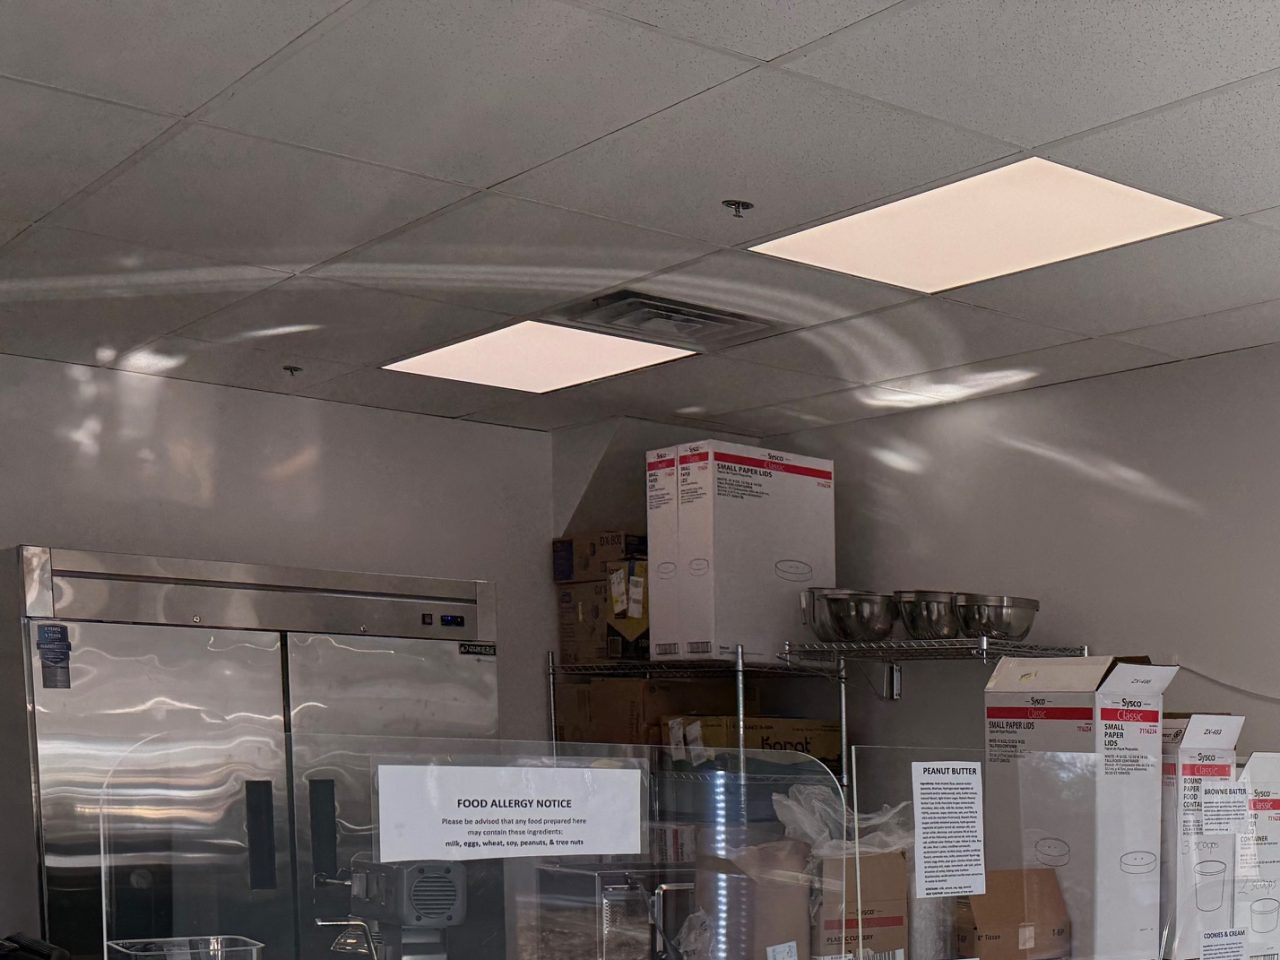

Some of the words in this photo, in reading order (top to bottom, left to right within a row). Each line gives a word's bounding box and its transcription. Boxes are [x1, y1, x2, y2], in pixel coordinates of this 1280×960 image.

[1030, 697, 1046, 707] Sysco
[1121, 698, 1142, 708] Sysco
[1117, 710, 1144, 721] Classic
[988, 721, 1005, 730] SMALL
[1005, 722, 1023, 730] PAPER
[1023, 721, 1035, 731] LIDS
[1104, 723, 1125, 731] SMALL
[1104, 731, 1125, 740] PAPER
[761, 735, 812, 753] Karat
[1197, 752, 1216, 763] Sysco
[922, 767, 951, 775] PEANUT
[951, 767, 977, 776] BUTTER
[1194, 764, 1219, 776] Classic
[1183, 793, 1198, 801] FOOD
[1204, 788, 1228, 796] BROWNIE
[1254, 789, 1271, 798] Sysco
[457, 799, 488, 809] FOOD
[490, 799, 534, 809] ALLERGY
[536, 799, 573, 809] NOTICE
[527, 817, 542, 825] food
[543, 818, 572, 827] prepared
[572, 817, 587, 825] here
[445, 840, 462, 848] milk,
[463, 841, 481, 849] eggs,
[482, 839, 505, 848] wheat,
[506, 840, 519, 848] soy,
[520, 839, 548, 848] peanuts,
[556, 838, 570, 846] tree
[570, 838, 585, 846] nuts
[1229, 929, 1246, 937] CREAM
